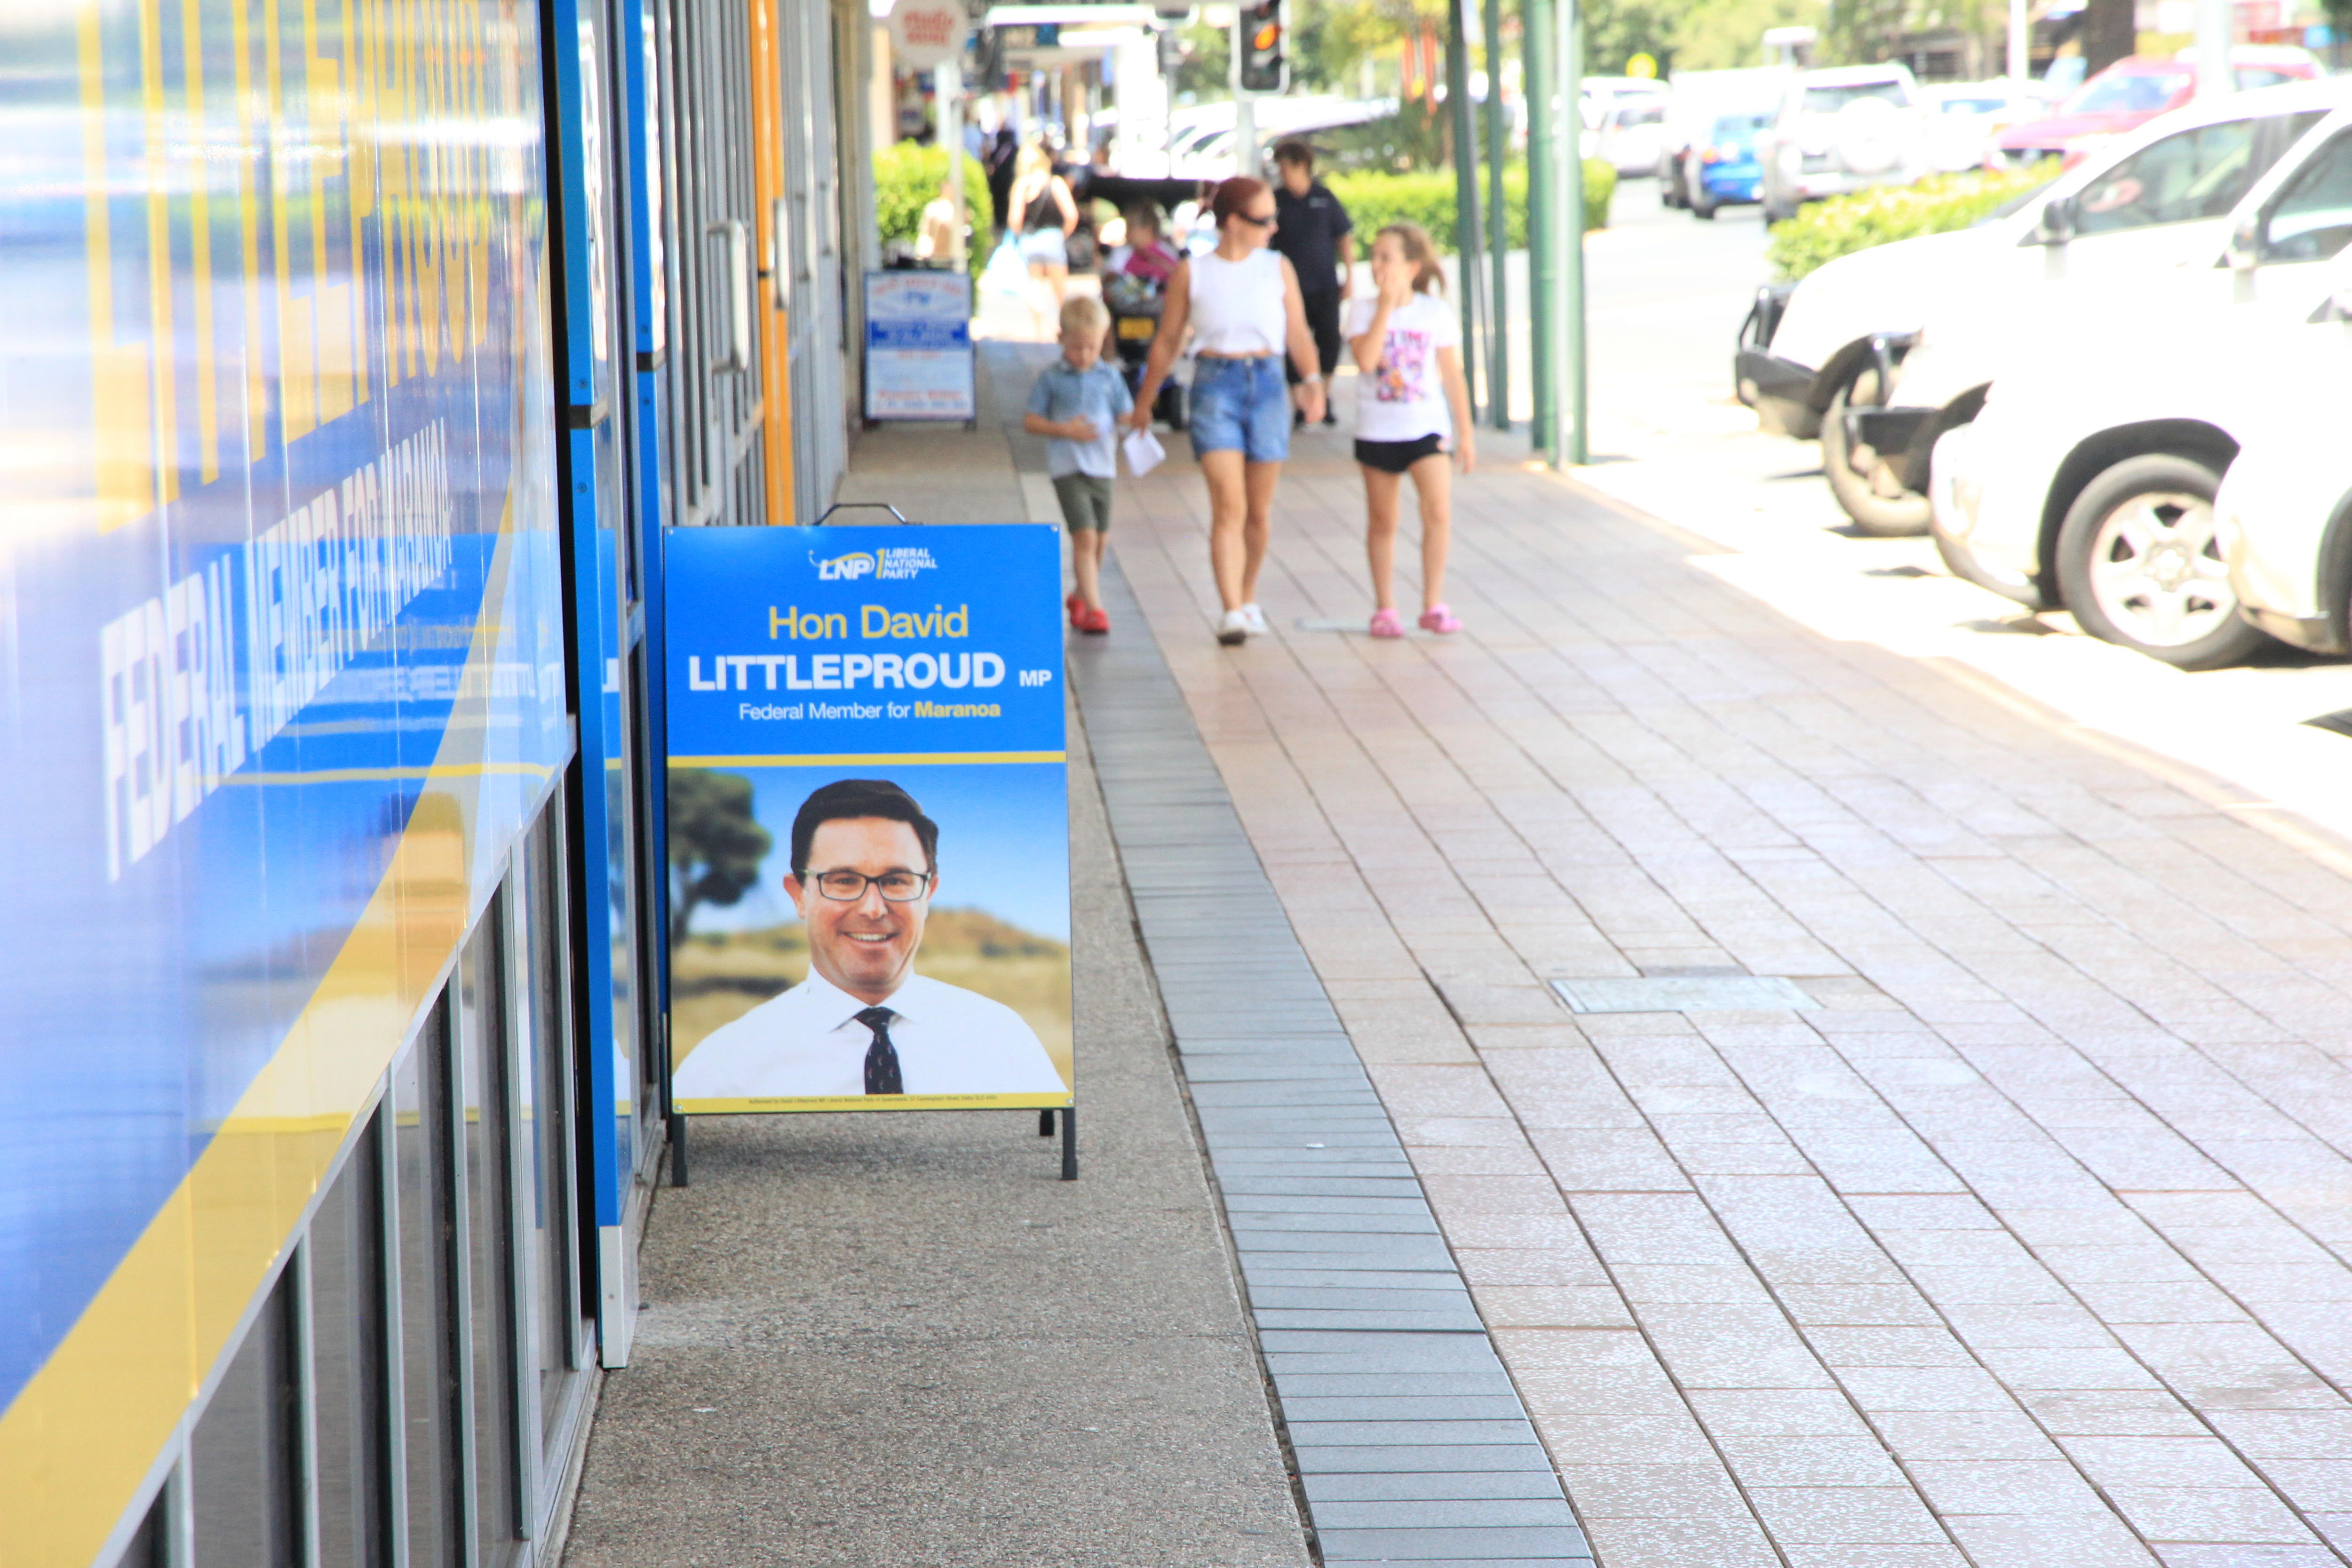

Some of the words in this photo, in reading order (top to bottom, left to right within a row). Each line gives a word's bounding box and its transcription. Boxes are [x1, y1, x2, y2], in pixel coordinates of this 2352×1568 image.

[886, 548, 930, 558] LIBERAL
[819, 559, 872, 580] LNP
[882, 569, 918, 578] PARTY
[884, 559, 937, 569] NATIONAL
[770, 606, 847, 639] Hon
[861, 604, 968, 638] David
[101, 553, 245, 883] FEDERAL
[245, 488, 342, 753] MEMBER
[342, 463, 382, 661] FOR
[380, 417, 453, 624] MARANOA
[690, 653, 1005, 691] LITTLEPROUD
[1020, 670, 1052, 686] MP
[740, 704, 803, 719] Federal
[810, 703, 882, 718] Member
[888, 702, 911, 718] for
[915, 701, 1001, 717] Maranoa
